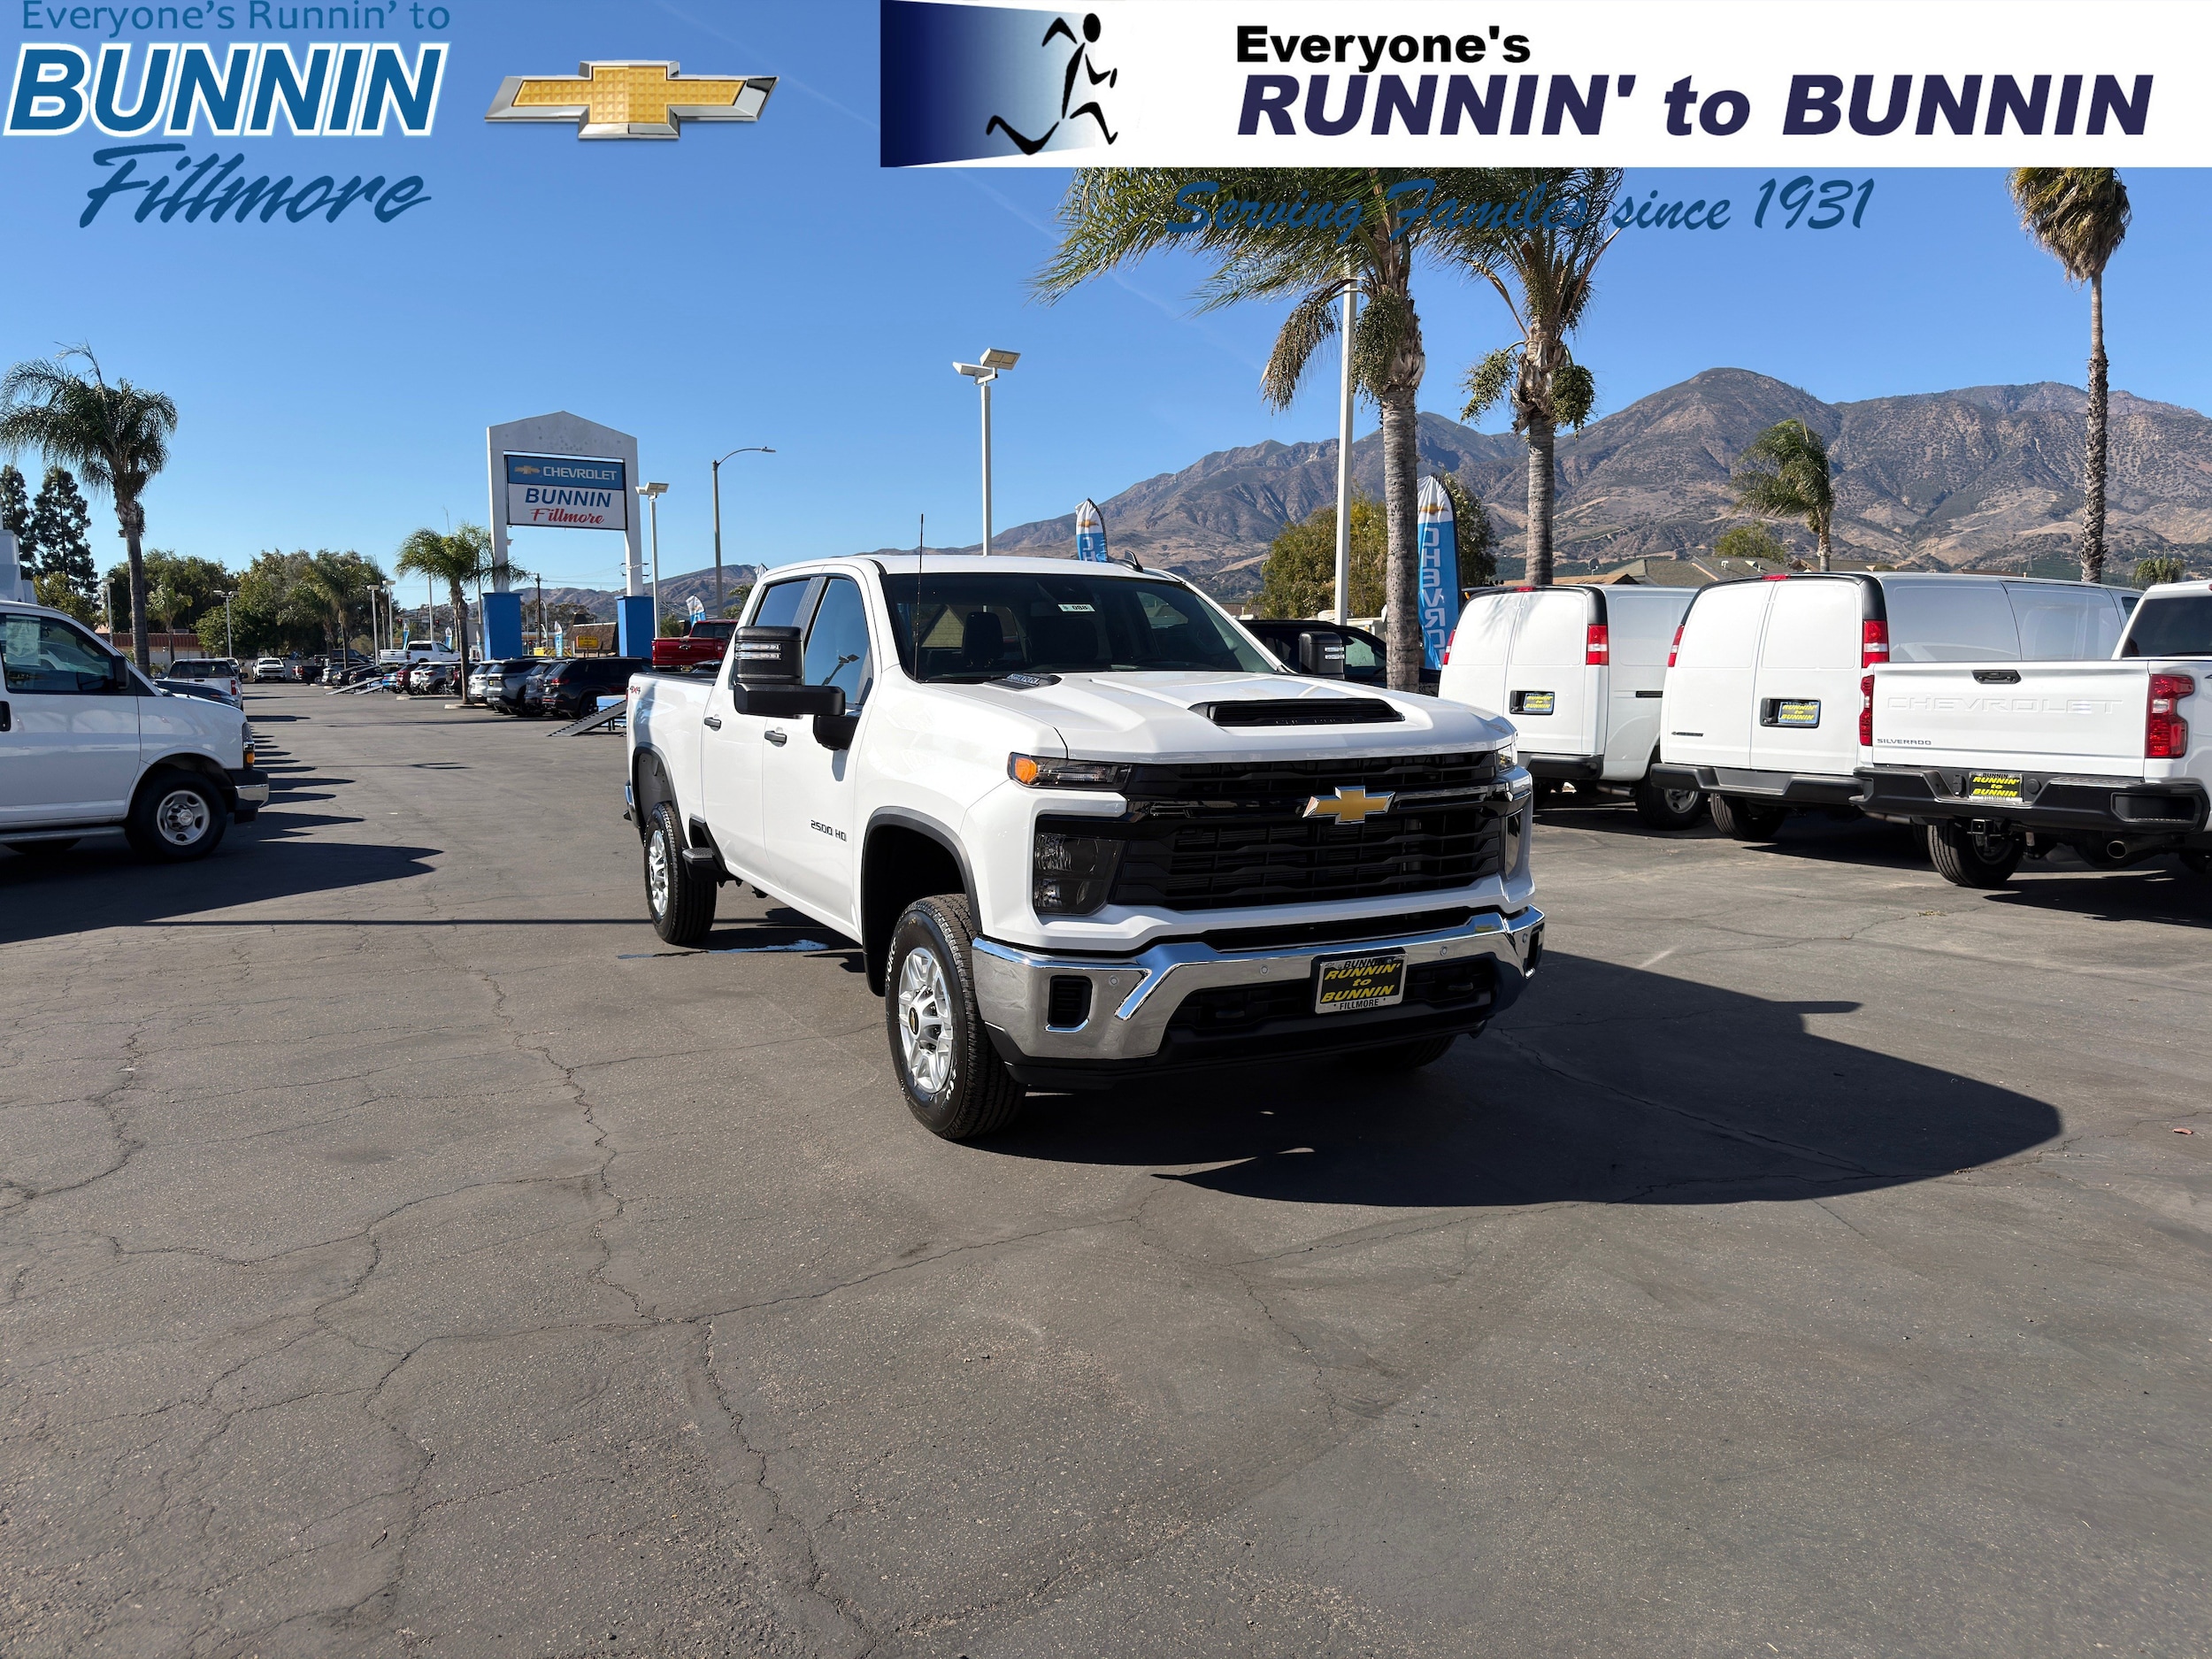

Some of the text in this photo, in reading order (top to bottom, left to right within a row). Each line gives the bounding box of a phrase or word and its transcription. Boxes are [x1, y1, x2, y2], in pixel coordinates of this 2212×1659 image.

[542, 465, 618, 481] CHEVROLET
[525, 488, 612, 508] BUNNIN
[530, 507, 605, 525] Fillmore
[1886, 695, 2124, 715] CHEVROLET
[1972, 787, 2018, 797] BUNNIN
[810, 819, 848, 842] 2500 HD
[1325, 963, 1402, 980] RUNNIN'
[1352, 978, 1372, 987] to
[1320, 984, 1395, 1002] BUNNIN
[1339, 998, 1379, 1010] FILLMORE
